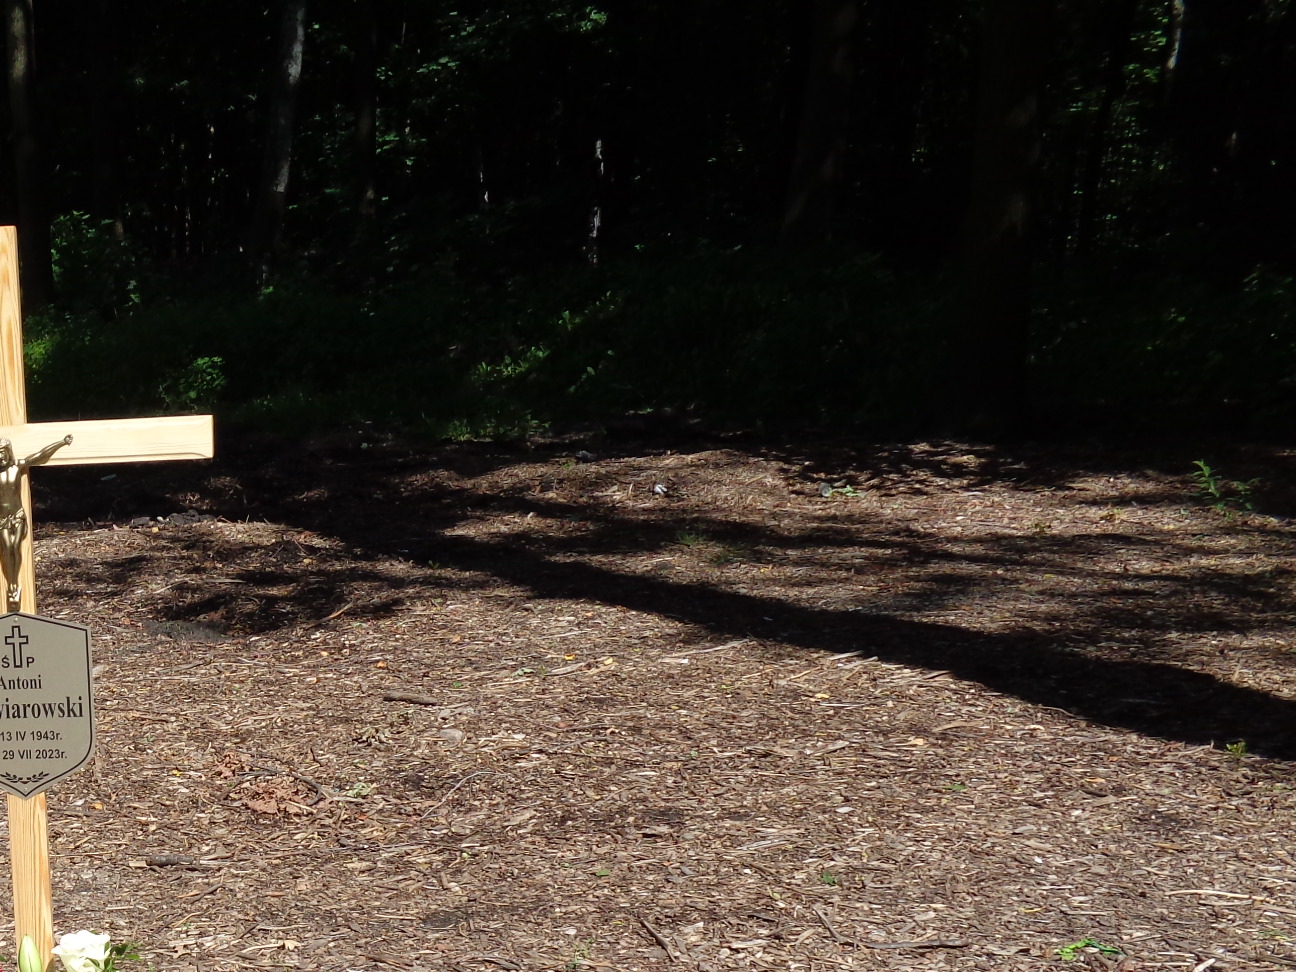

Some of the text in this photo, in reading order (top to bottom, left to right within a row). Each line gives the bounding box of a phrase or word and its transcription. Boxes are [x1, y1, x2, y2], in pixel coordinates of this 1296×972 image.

[27, 657, 35, 668] P
[0, 732, 12, 742] 13
[16, 731, 27, 741] IV
[30, 731, 63, 741] 1943r.
[3, 750, 15, 760] 29
[18, 750, 32, 759] VII
[36, 749, 68, 759] 2023r.
